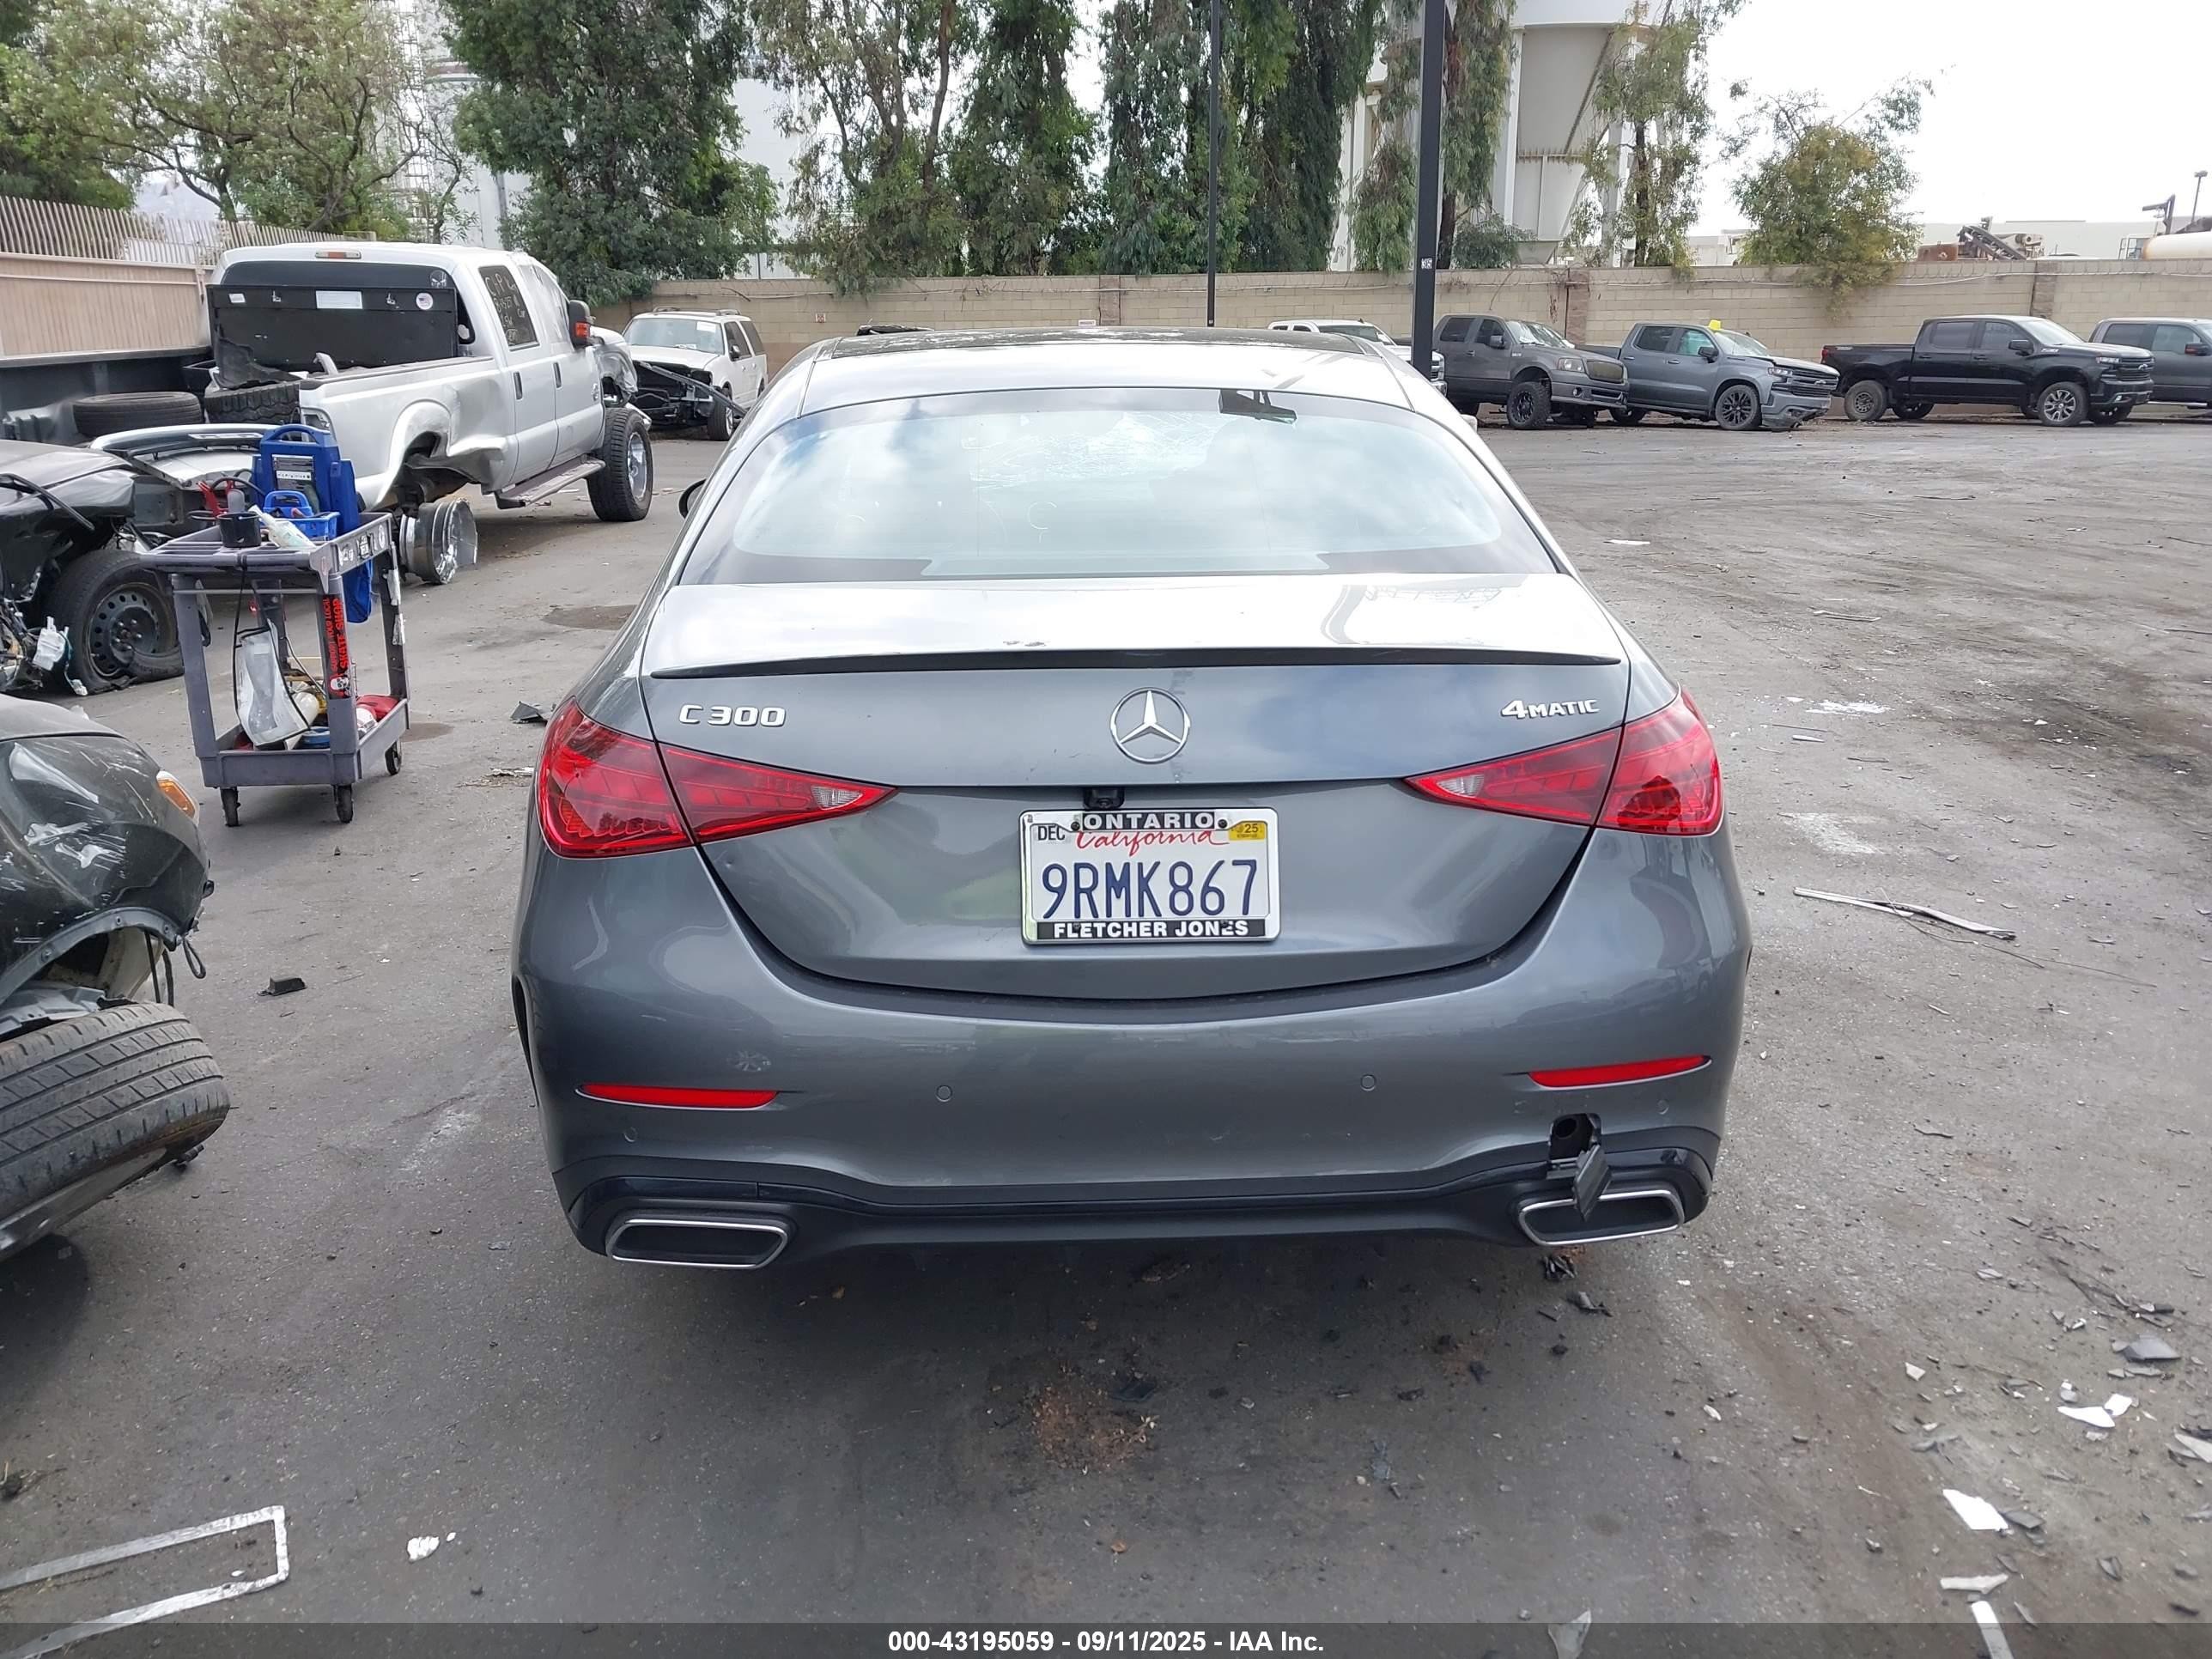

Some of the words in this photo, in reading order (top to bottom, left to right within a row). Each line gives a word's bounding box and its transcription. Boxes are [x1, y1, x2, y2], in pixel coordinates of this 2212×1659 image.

[332, 598, 344, 630] SHOP
[337, 634, 349, 669] SKATE
[679, 704, 703, 725] C
[707, 706, 786, 726] 300
[1501, 700, 1601, 720] 4MATIC
[1083, 812, 1214, 830] ONTARIO
[1244, 823, 1259, 834] 25
[1037, 825, 1066, 842] DEC
[1076, 830, 1229, 857] California
[1042, 860, 1257, 920] 9RMK867
[1054, 921, 1168, 939] FLETCHER
[1175, 921, 1249, 937] JONES
